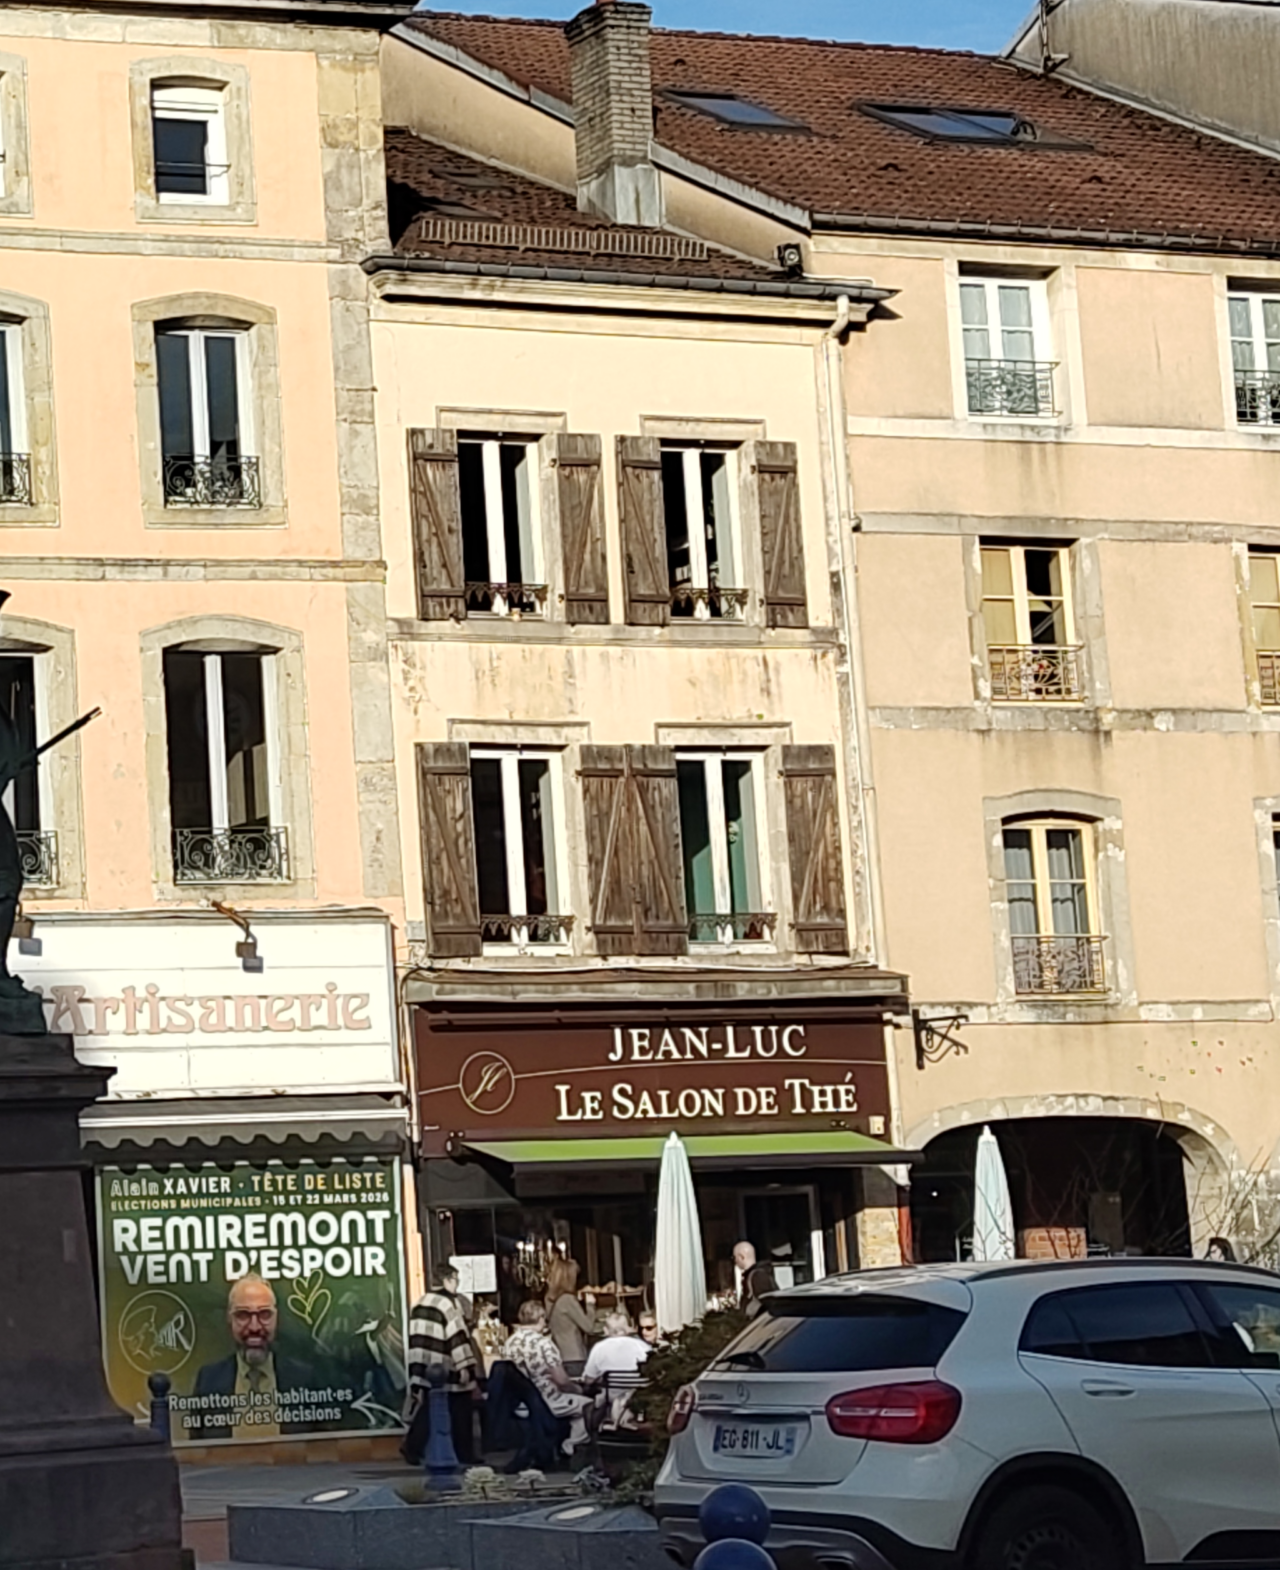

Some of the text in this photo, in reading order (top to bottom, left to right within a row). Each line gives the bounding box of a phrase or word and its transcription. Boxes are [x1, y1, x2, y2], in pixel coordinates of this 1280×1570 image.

[608, 1024, 807, 1062] JEAN-LUC
[554, 1072, 858, 1120] LE SALON DE THÉ
[111, 1172, 386, 1197] Alain XAVIER TÊTE DE LISTE
[180, 1196, 261, 1209] MUNICIPALES
[289, 1195, 302, 1205] ET
[323, 1193, 357, 1204] MARS
[360, 1191, 390, 1203] 2026
[113, 1210, 391, 1252] REMIREMONT
[120, 1246, 387, 1285] VENT D'ESPOIR
[170, 1393, 246, 1411] Remettons
[250, 1391, 270, 1406] les
[183, 1406, 342, 1429] au cœur des décisions
